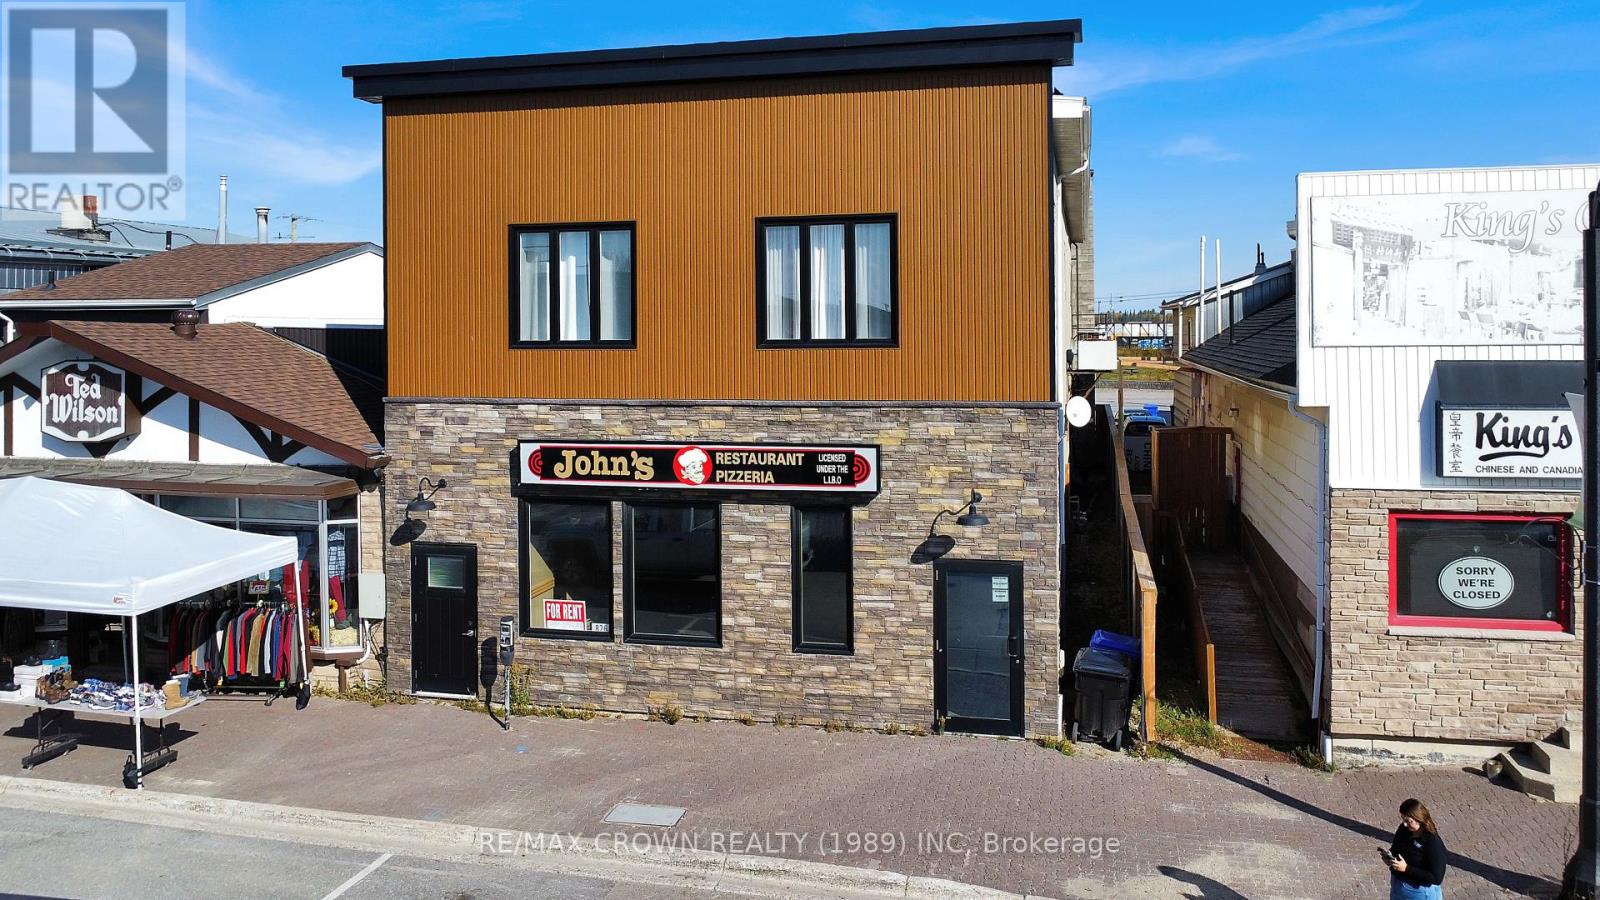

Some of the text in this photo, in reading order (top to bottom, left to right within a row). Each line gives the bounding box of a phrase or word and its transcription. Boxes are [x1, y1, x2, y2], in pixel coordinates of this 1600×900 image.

[1440, 200, 1565, 253] King's
[65, 373, 101, 399] Ted
[49, 393, 118, 423] Wilson
[1475, 412, 1573, 461] King's
[715, 452, 804, 466] RESTAURANT
[818, 453, 847, 462] LICENSED
[553, 449, 655, 480] John's
[816, 464, 849, 473] UNDER THE
[1475, 465, 1583, 475] CHINESE AND CANADIA
[715, 470, 775, 483] PIZZERIA
[1456, 566, 1496, 575] SORRY
[1458, 578, 1495, 587] WE'RE
[1453, 590, 1500, 599] CLOSED
[546, 602, 583, 620] FOR RENT
